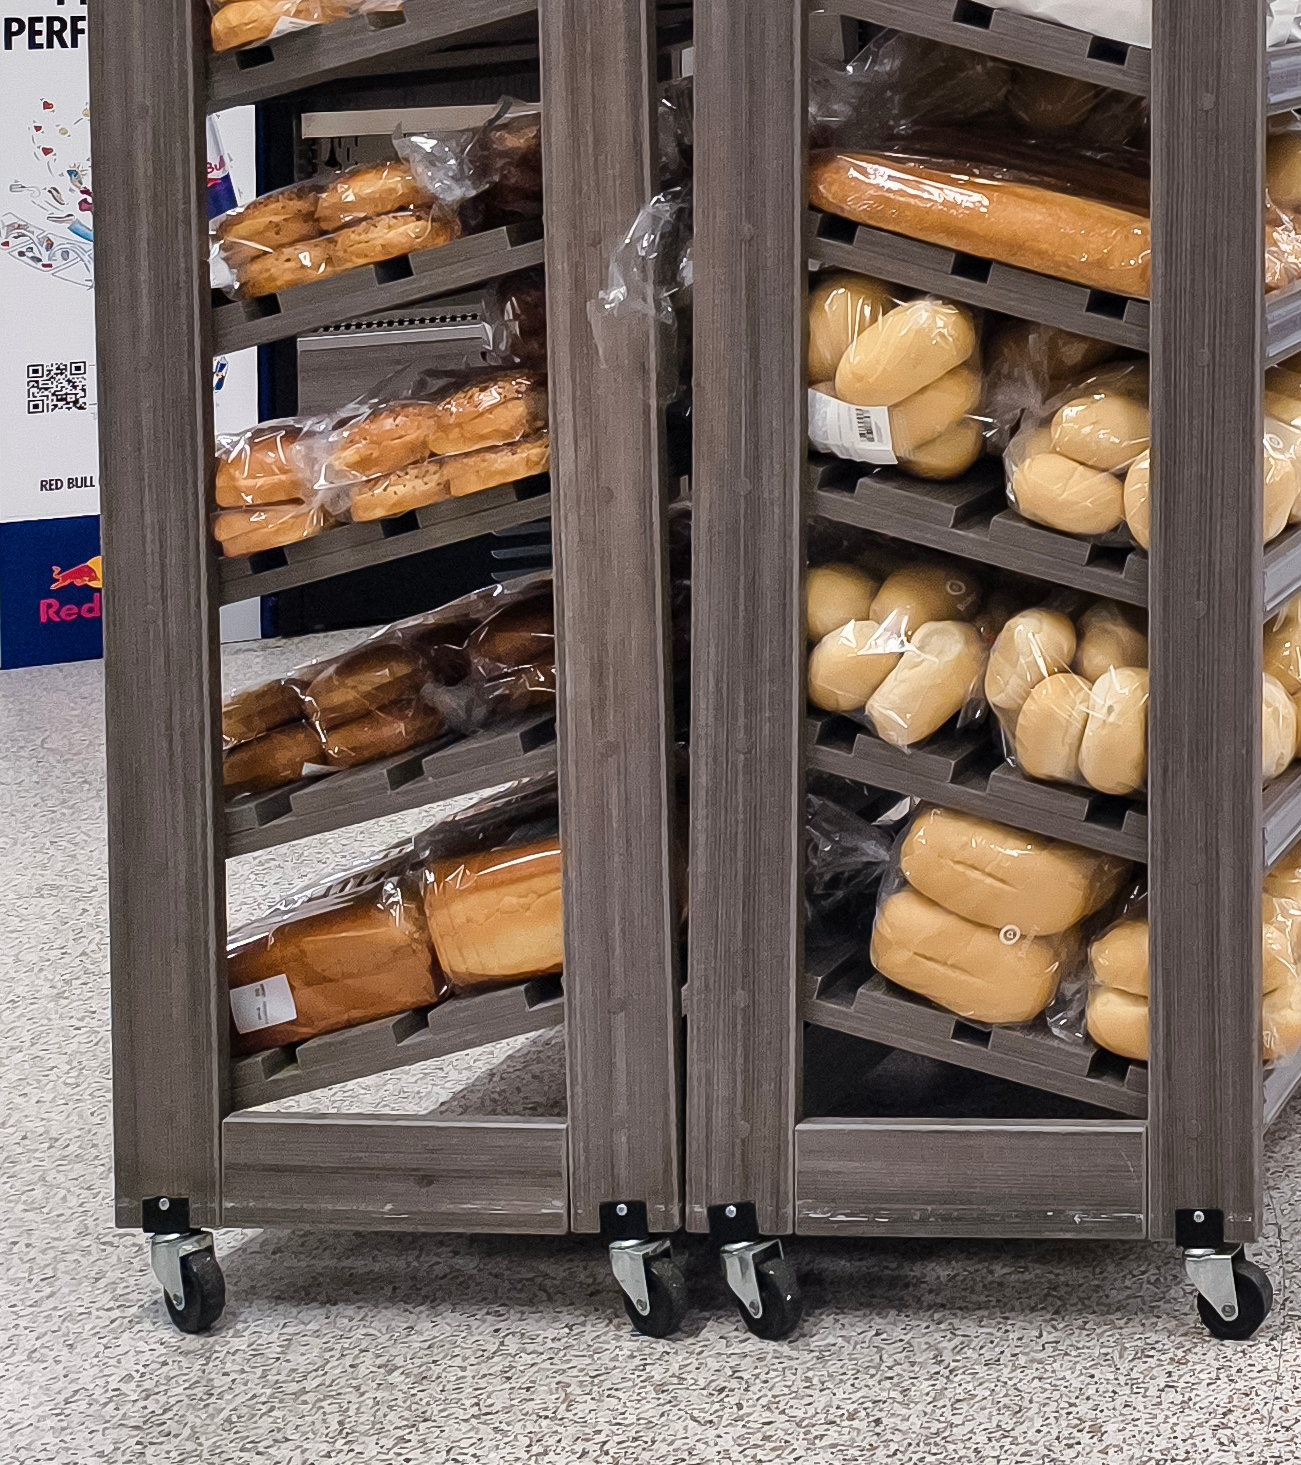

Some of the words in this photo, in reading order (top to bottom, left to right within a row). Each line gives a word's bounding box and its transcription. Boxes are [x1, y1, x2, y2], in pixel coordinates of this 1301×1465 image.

[40, 479, 64, 492] RED
[67, 475, 95, 490] BULL
[39, 593, 101, 624] Red
